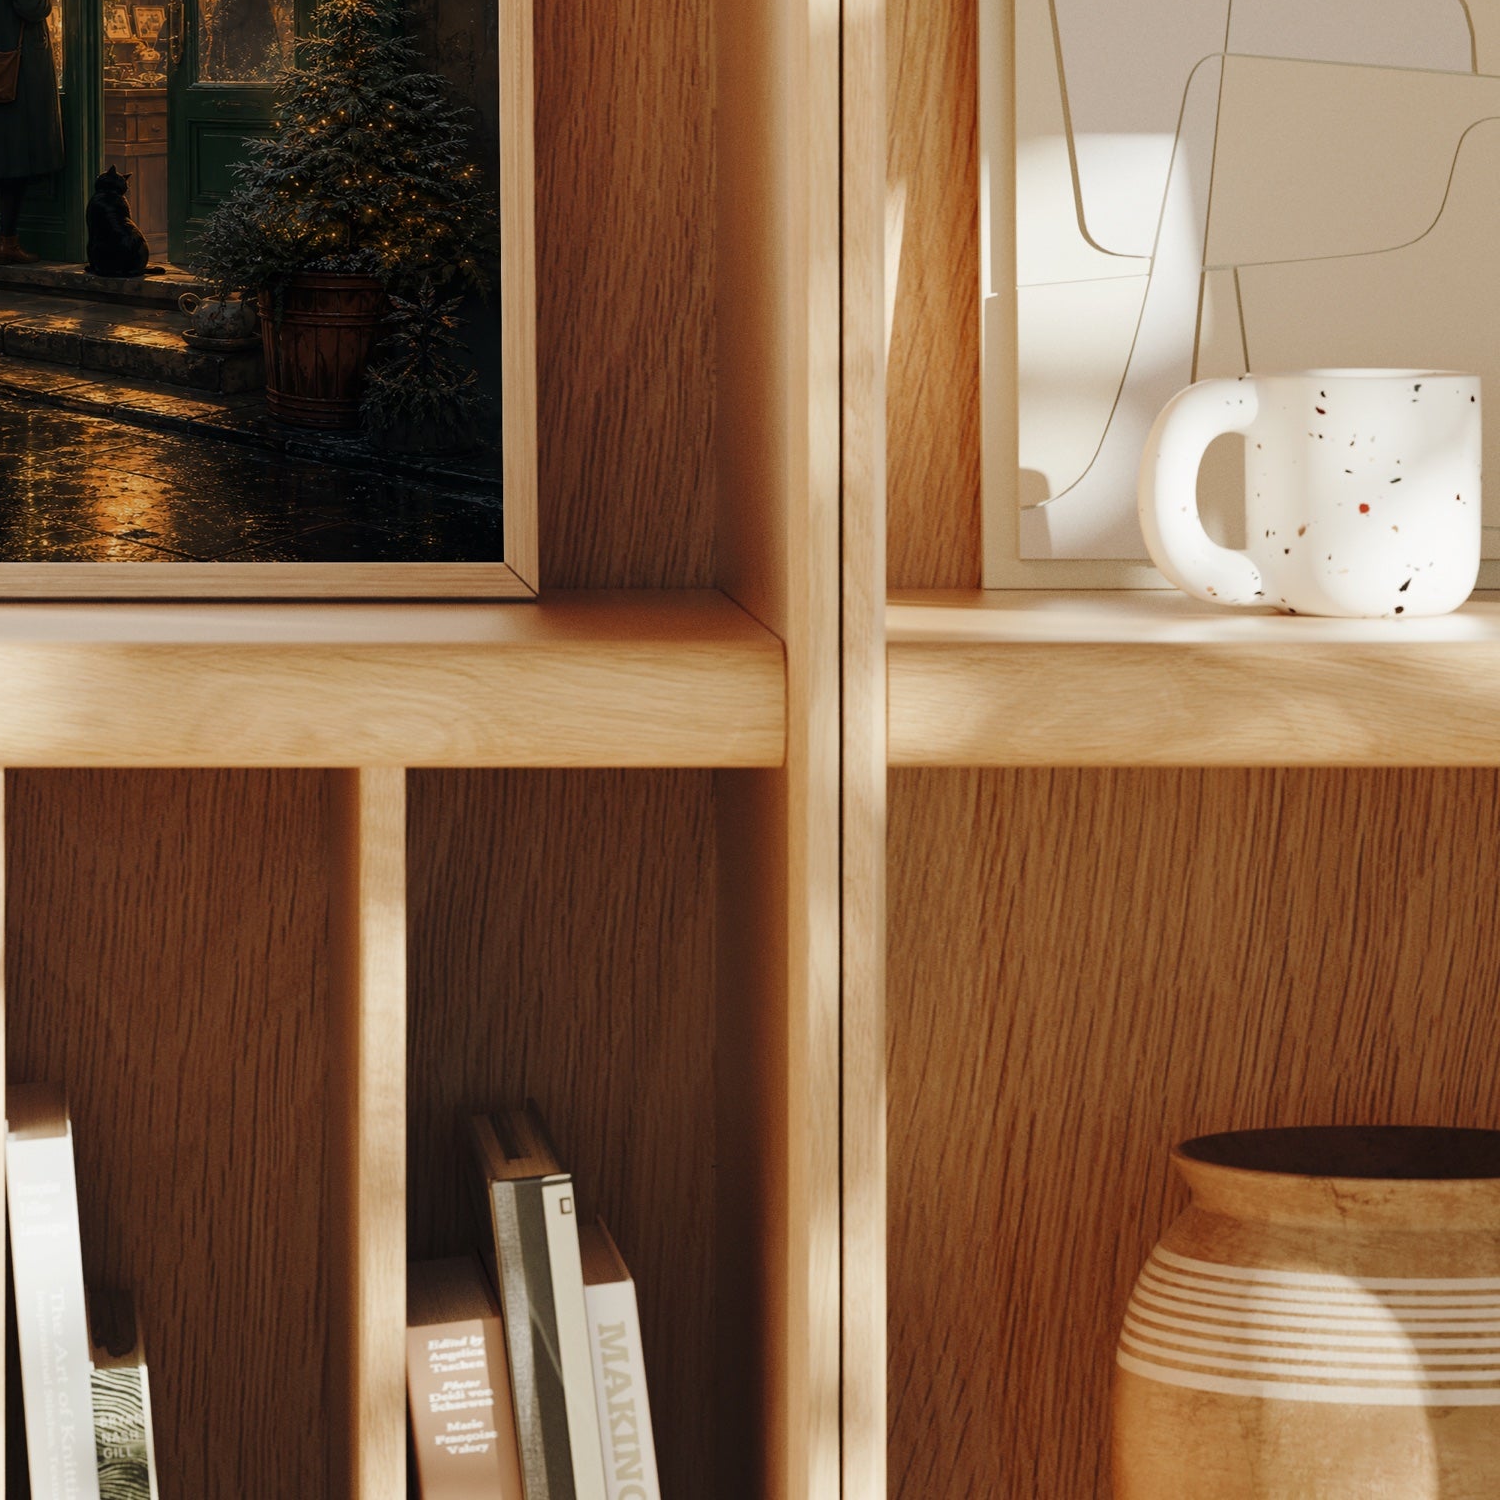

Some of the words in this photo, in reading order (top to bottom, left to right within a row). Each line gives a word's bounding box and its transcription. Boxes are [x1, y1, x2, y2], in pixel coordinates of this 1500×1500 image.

[52, 1288, 67, 1335] The
[54, 1343, 69, 1383] Art
[57, 1392, 73, 1416] of
[103, 1446, 132, 1459] GILL
